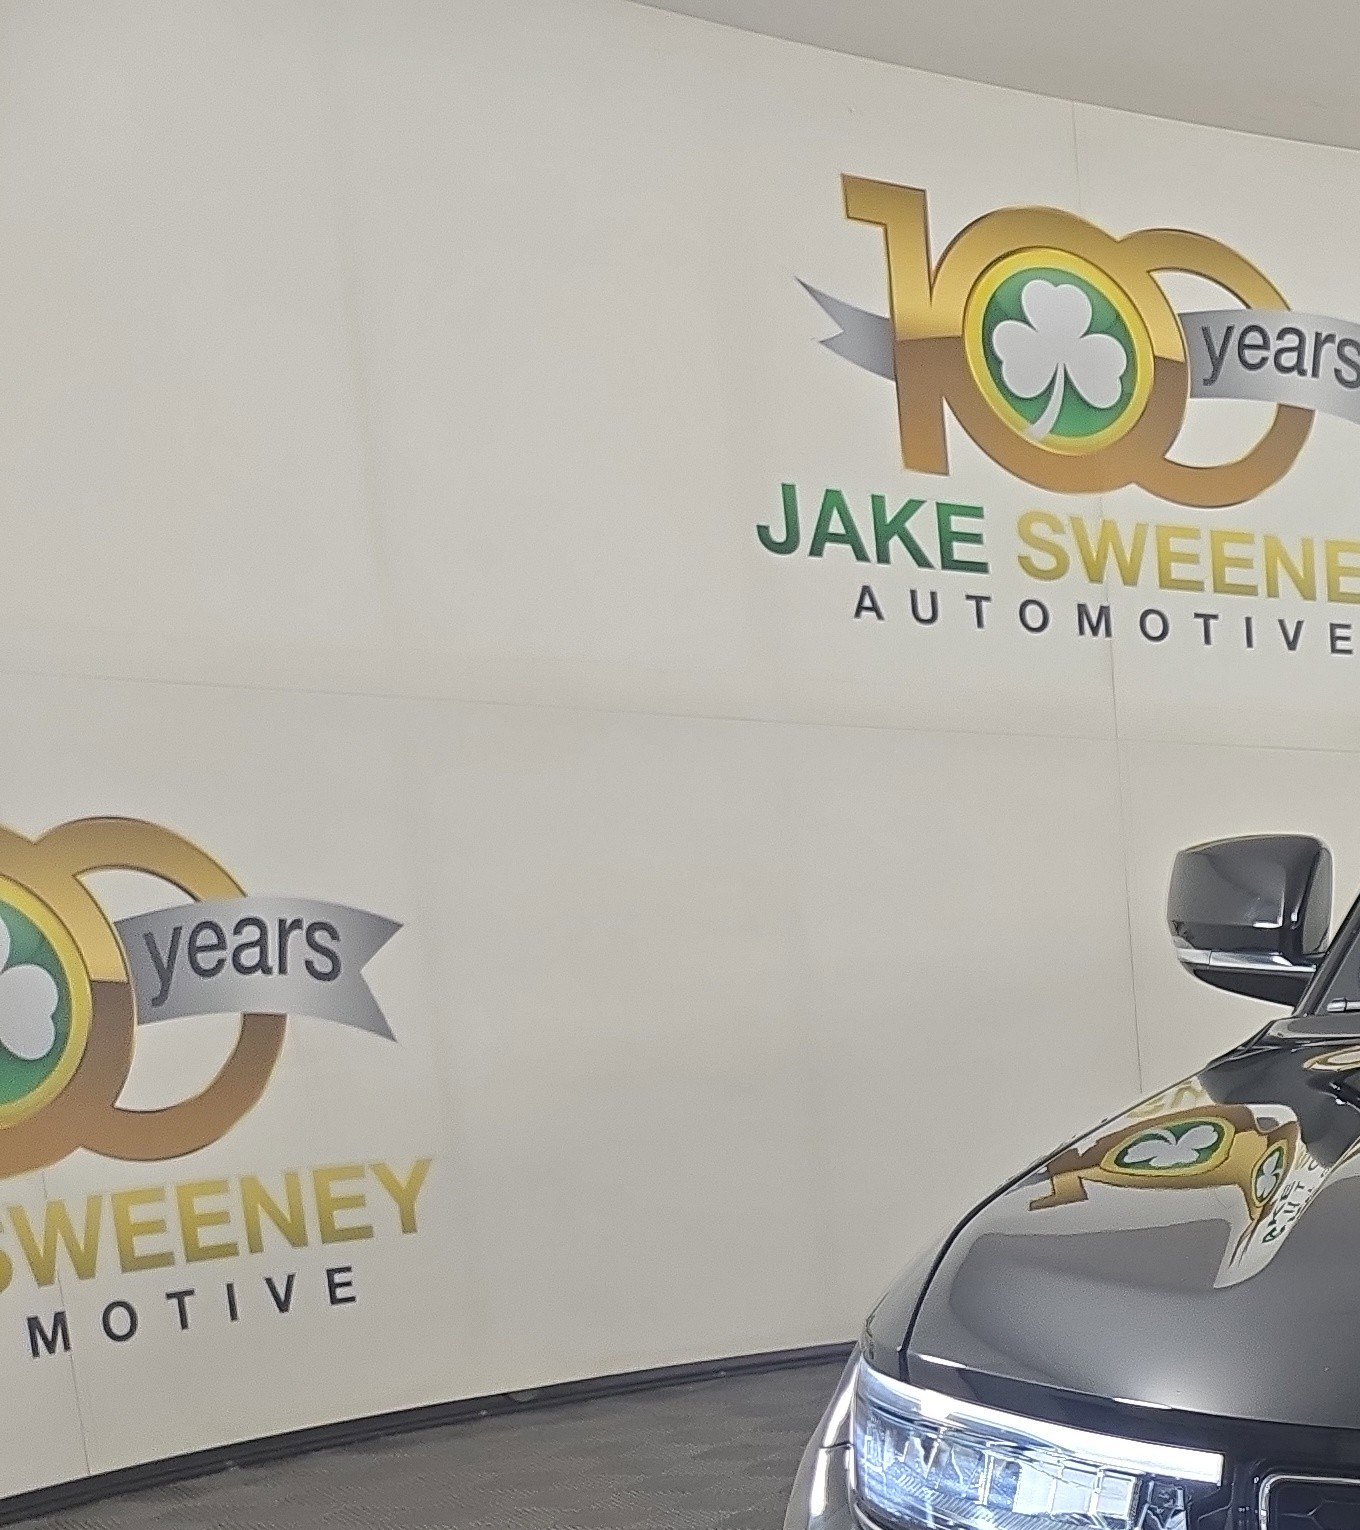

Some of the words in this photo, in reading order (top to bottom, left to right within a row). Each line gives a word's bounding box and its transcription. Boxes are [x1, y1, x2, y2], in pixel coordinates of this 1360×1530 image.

[756, 483, 990, 575] JAKE
[854, 584, 1354, 655] AUTOMOTIVE
[143, 916, 342, 1007] years
[0, 1159, 433, 1295] WEENEY
[26, 1267, 357, 1357] MOTIVE
